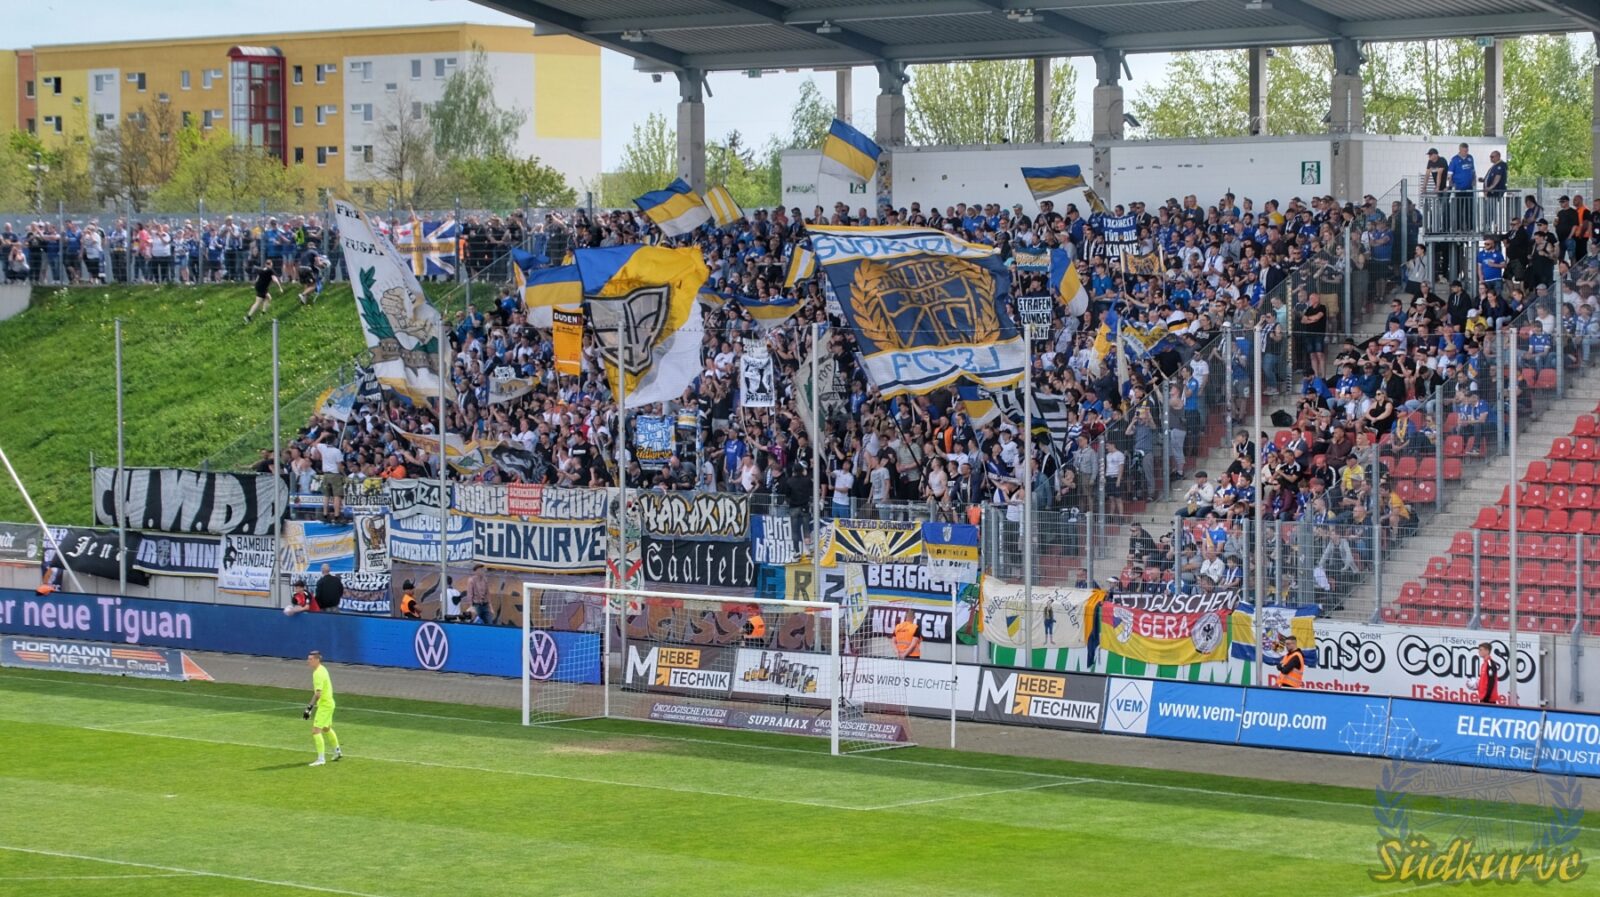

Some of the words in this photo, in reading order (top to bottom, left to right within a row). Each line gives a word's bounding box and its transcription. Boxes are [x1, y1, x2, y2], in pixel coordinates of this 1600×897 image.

[1124, 229, 1138, 241] DIE
[400, 514, 463, 532] UNBEUGAM
[237, 536, 275, 552] BAMBULE
[474, 521, 606, 563] SÜDKURVE
[236, 551, 274, 568] RANDALE
[23, 598, 91, 631] neue
[98, 597, 193, 643] Tiguan
[1139, 613, 1190, 639] GERA
[12, 640, 111, 658] HOFMANN
[659, 650, 698, 665] HEBE-
[50, 652, 125, 669] METALL
[673, 670, 728, 688] TECHNIK
[1018, 677, 1063, 694] HEBE-
[1033, 699, 1097, 720] TECHNIK
[1115, 698, 1143, 713] VEM
[747, 714, 810, 730] SUPRAMAX
[814, 718, 868, 731] ÖKOGISCHE
[1158, 700, 1328, 732] www.vem-group.com
[1456, 715, 1600, 745] ELEKTROMOTO
[1477, 743, 1506, 758] FÜR
[1510, 746, 1533, 760] DIE
